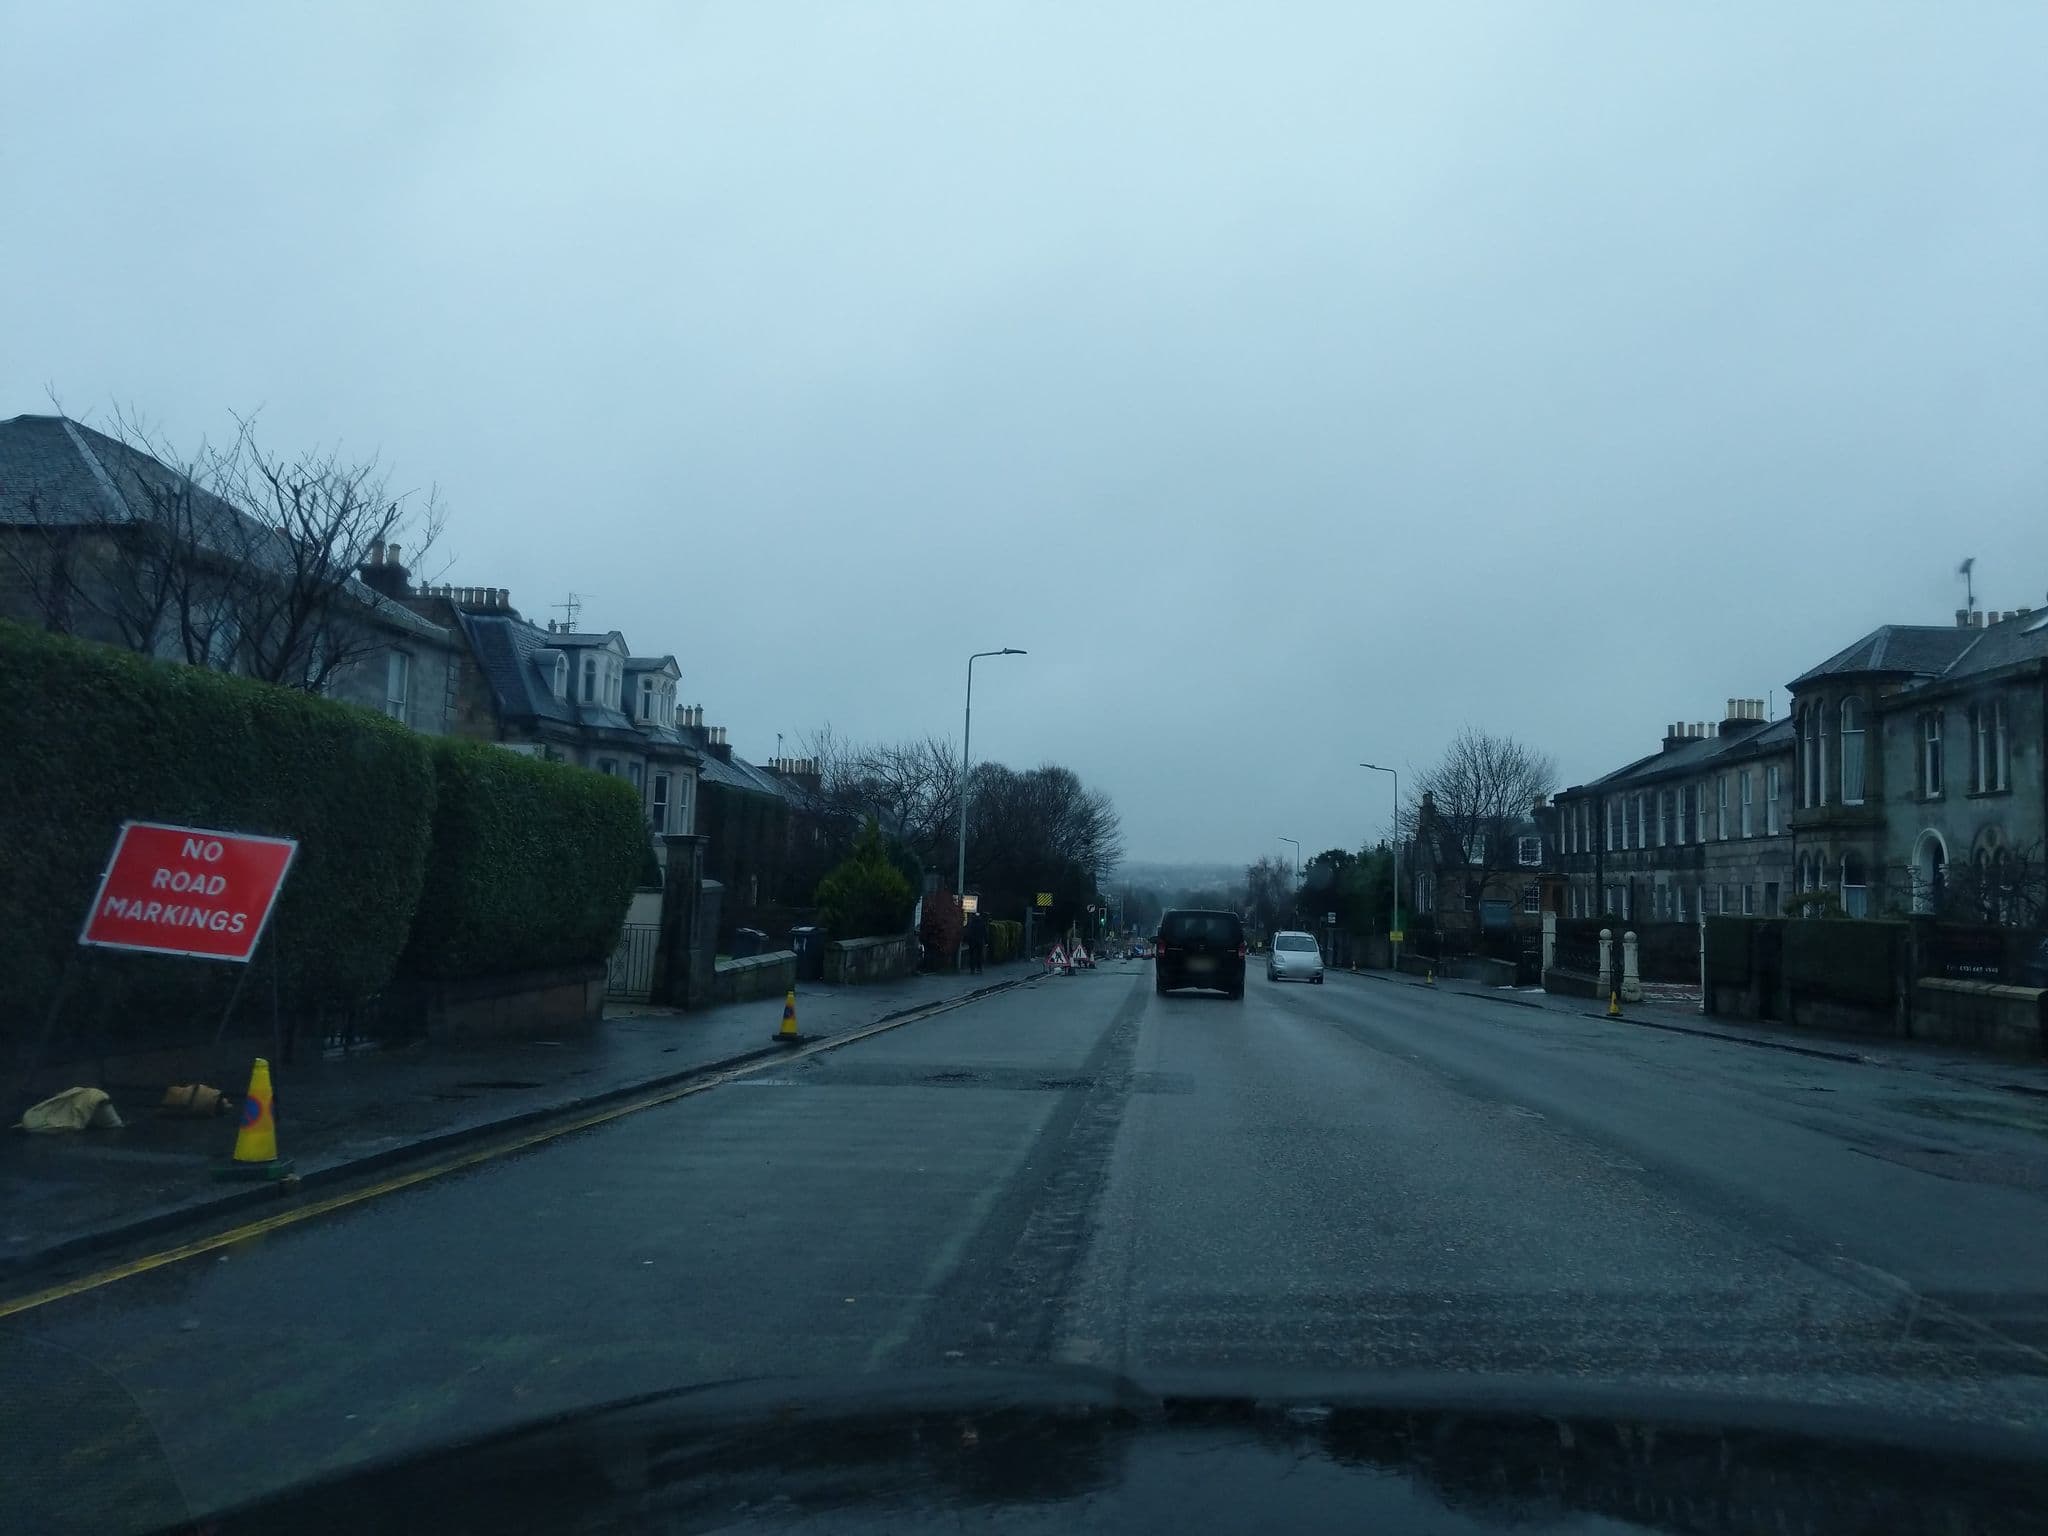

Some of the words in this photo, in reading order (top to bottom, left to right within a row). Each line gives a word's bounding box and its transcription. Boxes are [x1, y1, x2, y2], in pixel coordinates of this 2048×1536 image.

[182, 838, 223, 861] NO
[152, 869, 226, 895] ROAD
[104, 897, 248, 933] MARKINGS
